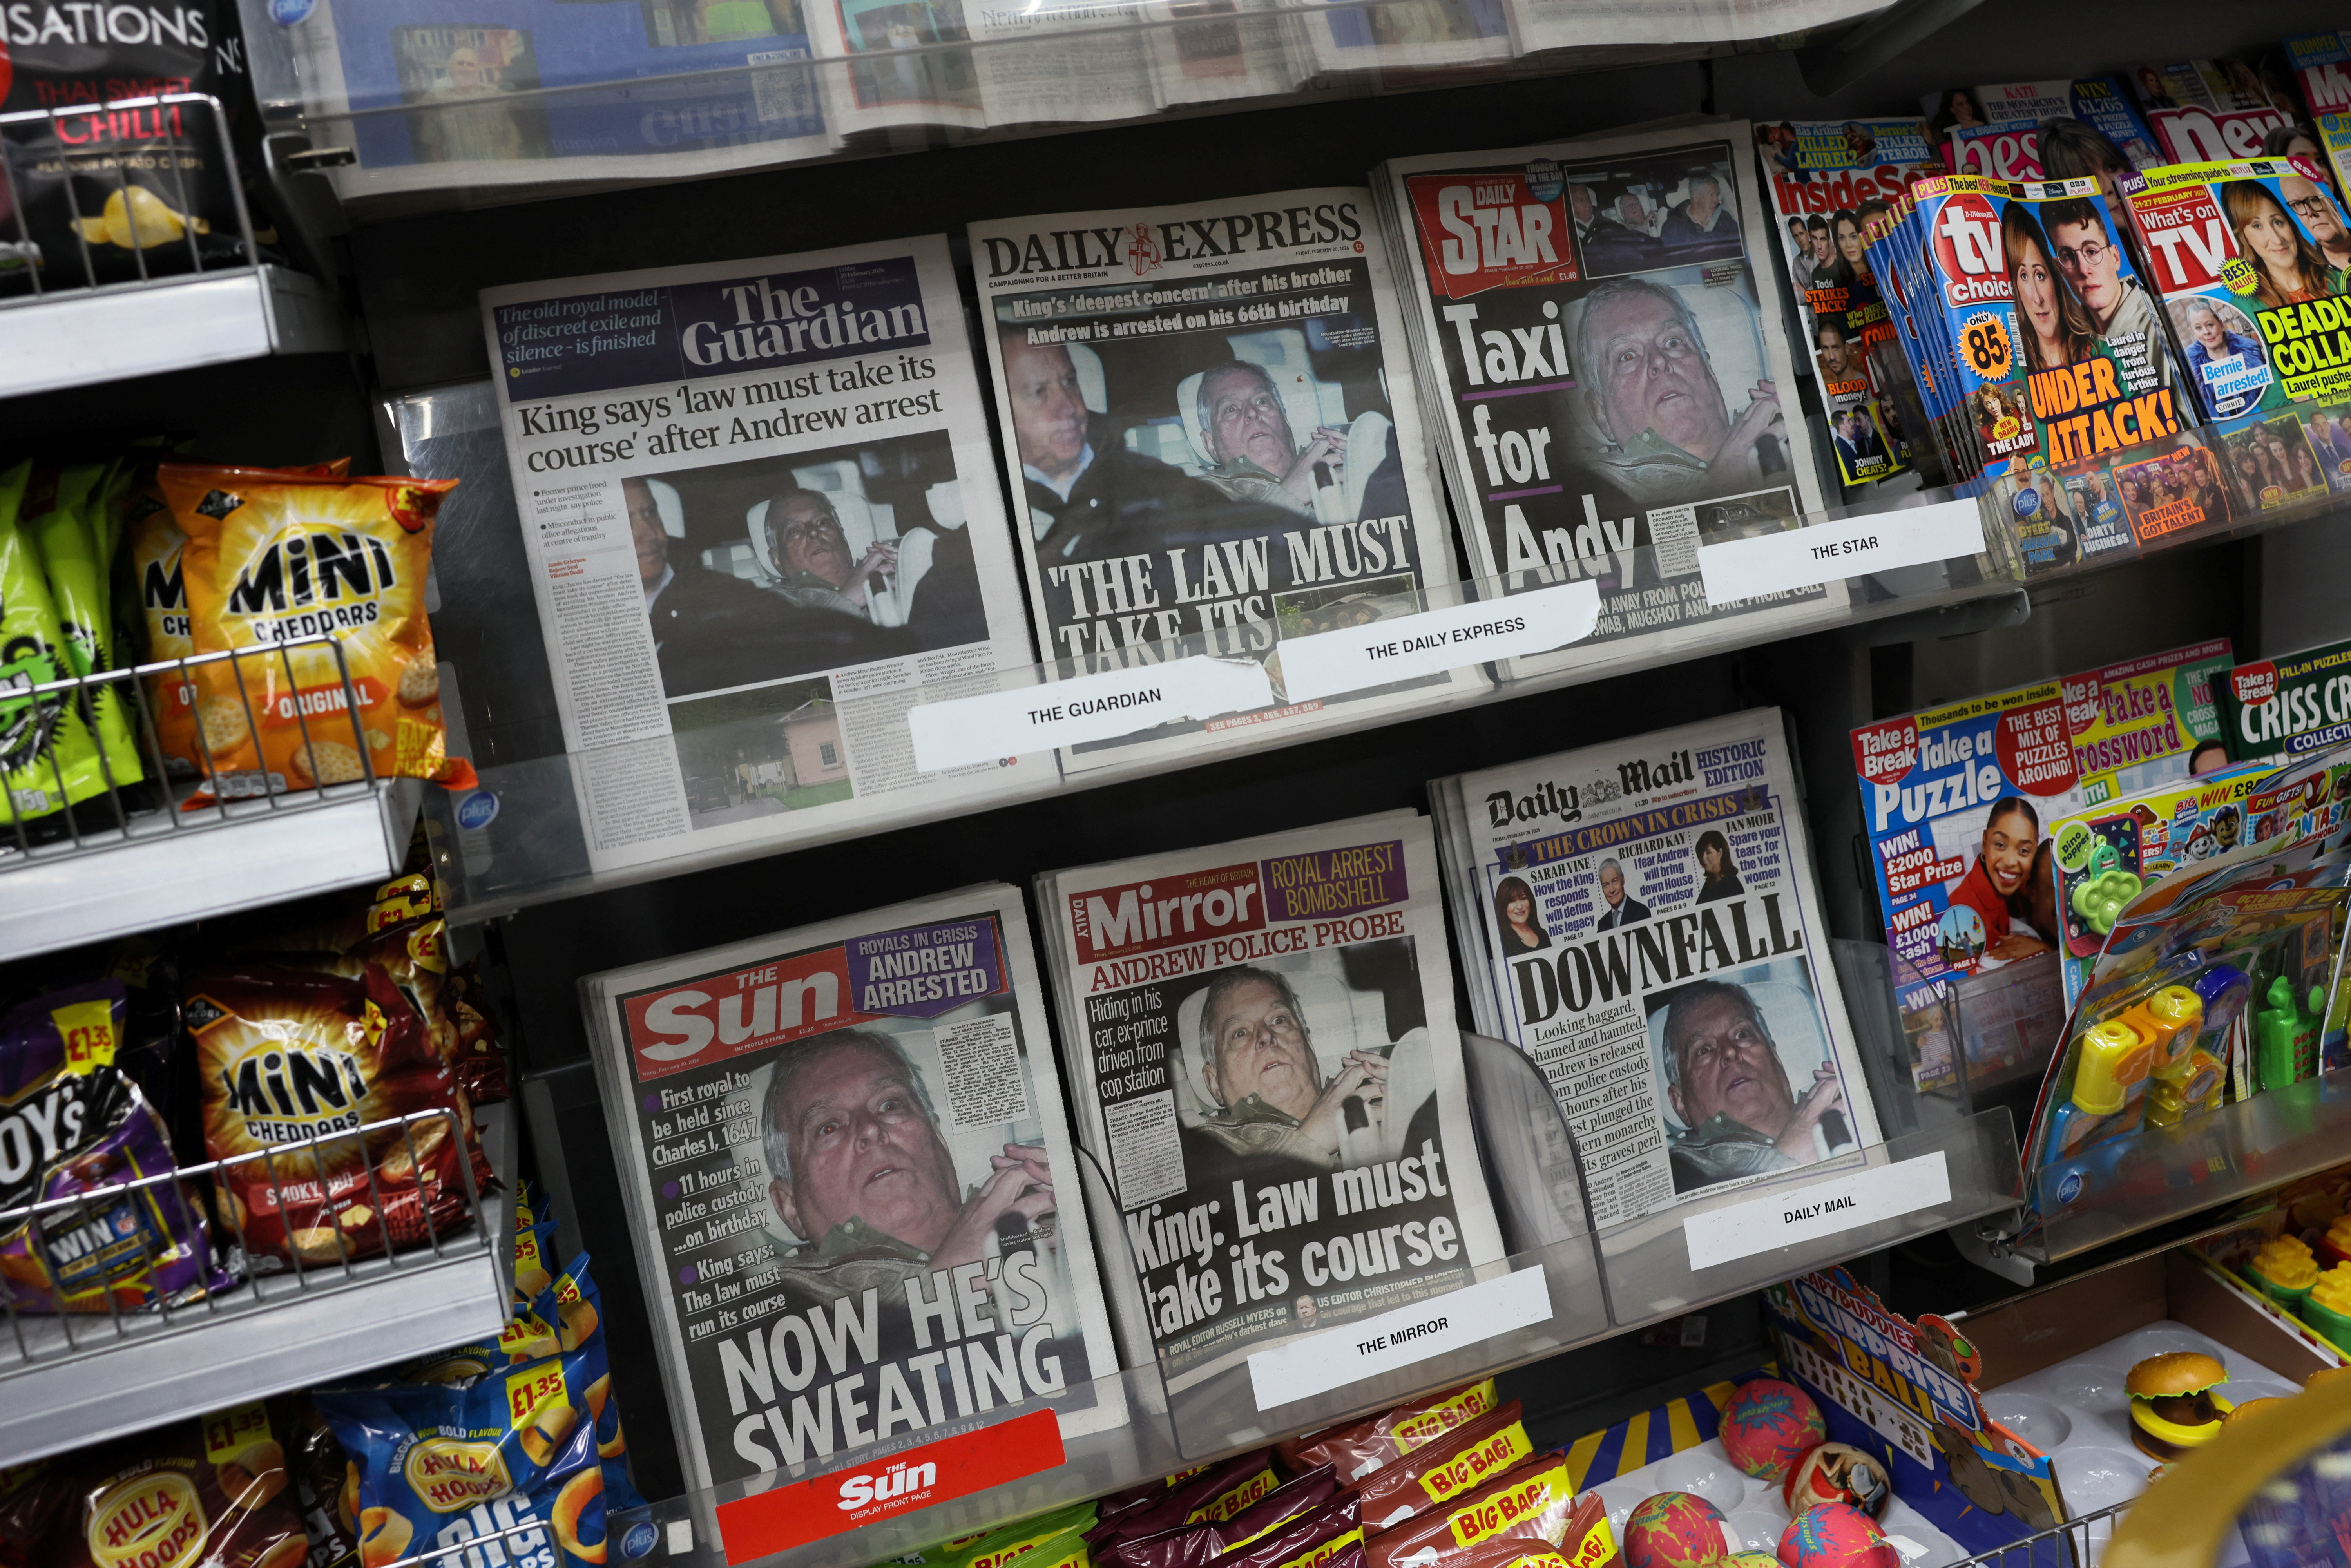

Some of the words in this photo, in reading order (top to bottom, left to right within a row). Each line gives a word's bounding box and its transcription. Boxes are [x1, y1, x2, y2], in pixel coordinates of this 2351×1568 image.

[1476, 184, 1516, 205] DAILY
[2123, 177, 2145, 193] PLUS!
[2147, 175, 2166, 188] Your
[2167, 170, 2203, 185] streaming
[2204, 168, 2221, 182] guide
[2222, 168, 2230, 177] to
[1438, 185, 1558, 275] STAR
[2196, 204, 2217, 219] on
[982, 228, 1124, 278] DAILY
[1157, 203, 1362, 262] EXPRESS
[1940, 206, 2003, 274] tv
[2148, 218, 2221, 285] TV
[989, 277, 1035, 288] CAMPAIGNING
[1058, 273, 1081, 281] BETTER
[1083, 271, 1108, 279] BRITAIN
[1193, 259, 1230, 270] express.co.uk
[1217, 278, 1259, 297] after
[1262, 274, 1288, 292] his
[1291, 267, 1352, 289] brother
[1559, 271, 1577, 281] £1.40
[2222, 259, 2249, 281] BEST
[2230, 273, 2256, 292] VALUE!
[722, 278, 820, 325] The
[683, 301, 927, 365] Guardian
[1443, 301, 1569, 386] Taxi
[1828, 379, 1867, 395] BLOOD
[2027, 357, 2120, 419] UNDER
[2204, 358, 2242, 380] Bernie
[2217, 367, 2270, 397] arrested!
[518, 403, 600, 436] King
[603, 394, 671, 427] says
[744, 374, 822, 407] must
[826, 360, 894, 396] take
[898, 354, 936, 383] its
[1835, 390, 1865, 403] money!
[647, 416, 723, 456] after
[728, 405, 849, 445] Andrew
[855, 389, 943, 424] arrest
[2047, 389, 2179, 465] ATTACK!
[1474, 406, 1552, 487] for
[1855, 454, 1884, 468] JOHNNY
[1856, 464, 1887, 477] CHEATS?
[542, 531, 560, 539] office
[561, 525, 598, 537] allegations
[548, 519, 587, 529] Misconduct
[596, 513, 617, 522] public
[2143, 525, 2161, 537] GOT
[2164, 509, 2201, 530] TALENT
[1167, 536, 1269, 604] LAW
[1283, 514, 1409, 586] MUST
[1503, 494, 1636, 590] Andy
[1811, 544, 1839, 560] THE
[1842, 536, 1878, 554] STAR
[255, 601, 378, 642] CHEDDARS
[1058, 606, 1187, 680] TAKE
[1195, 593, 1273, 657] ITS
[1366, 643, 1398, 660] THE
[1402, 633, 1447, 653] DAILY
[1452, 617, 1525, 643] EXPRESS
[280, 687, 373, 717] ORIGINAL
[1028, 707, 1063, 726] THE
[1069, 689, 1161, 717] GUARDIAN
[1210, 722, 1225, 730] SEE
[1227, 716, 1252, 727] PAGES
[1263, 710, 1282, 720] 4&5,
[1284, 706, 1301, 716] 6&7,
[1303, 702, 1318, 712] 8&9
[1695, 739, 1766, 769] HISTORIC
[1920, 730, 1973, 771] Take
[1976, 730, 1992, 756] a
[1485, 781, 1582, 829] Daily
[1617, 749, 1695, 796] Mail
[1704, 759, 1765, 787] EDITION
[1875, 759, 2001, 832] Puzzle
[1532, 834, 1574, 862] THE
[1577, 813, 1646, 850] CROWN
[1649, 809, 1669, 833] IN
[1672, 794, 1737, 826] CRISIS
[1186, 878, 1197, 888] THE
[1199, 875, 1219, 886] HEART
[1220, 873, 1228, 883] OF
[1230, 869, 1254, 882] BRITAIN
[1271, 857, 1322, 888] ROYAL
[1331, 844, 1395, 876] ARREST
[1531, 864, 1566, 883] SARAH
[1567, 857, 1591, 873] VINE
[1887, 848, 1933, 875] £2000
[1889, 868, 1920, 892] Star
[1924, 859, 1962, 882] Prize
[1085, 882, 1257, 951] Mirror
[1286, 877, 1390, 917] BOMBSHELL
[1072, 899, 1088, 938] DAILY
[859, 934, 910, 956] ROYALS
[914, 932, 929, 947] IN
[933, 925, 978, 944] CRISIS
[1090, 945, 1207, 992] ANDREW
[1214, 927, 1309, 965] POLICE
[1315, 910, 1405, 947] PROBE
[1512, 893, 1803, 1026] DOWNFALL
[735, 967, 777, 989] THE
[869, 942, 973, 981] ANDREW
[864, 968, 987, 1010] ARRESTED
[639, 970, 840, 1061] Sun
[642, 1068, 658, 1077] Friday,
[659, 1064, 679, 1073] February
[661, 1086, 694, 1109] First
[697, 1072, 732, 1099] royal
[735, 1073, 750, 1088] to
[652, 1120, 671, 1139] be
[676, 1105, 709, 1132] held
[714, 1099, 750, 1121] since
[652, 1138, 706, 1166] Charles
[708, 1131, 719, 1151] I,
[722, 1117, 757, 1145] 1647
[1126, 1200, 1225, 1273] King:
[1232, 1177, 1319, 1238] Law
[1332, 1137, 1446, 1216] must
[1784, 1204, 1821, 1224] DAILY
[1824, 1195, 1856, 1214] MAIL
[1142, 1257, 1224, 1340] take
[1229, 1240, 1290, 1305] its
[1301, 1215, 1459, 1287] course
[717, 1288, 880, 1416] NOW
[1357, 1338, 1387, 1356] THE
[1390, 1317, 1450, 1346] MIRROR
[1804, 1293, 1976, 1415] SURPRISE
[1846, 1334, 1932, 1421] BALL
[733, 1324, 1067, 1497] SWEATING
[424, 1453, 487, 1477] HULA
[886, 1462, 906, 1474] THE
[1429, 1462, 1468, 1496] BIG
[1467, 1434, 1512, 1478] BAG!
[430, 1470, 505, 1504] HOOPS
[837, 1462, 936, 1510] Sun
[850, 1505, 882, 1520] DISPLAY
[884, 1497, 909, 1510] FRONT
[911, 1490, 932, 1502] PAGE
